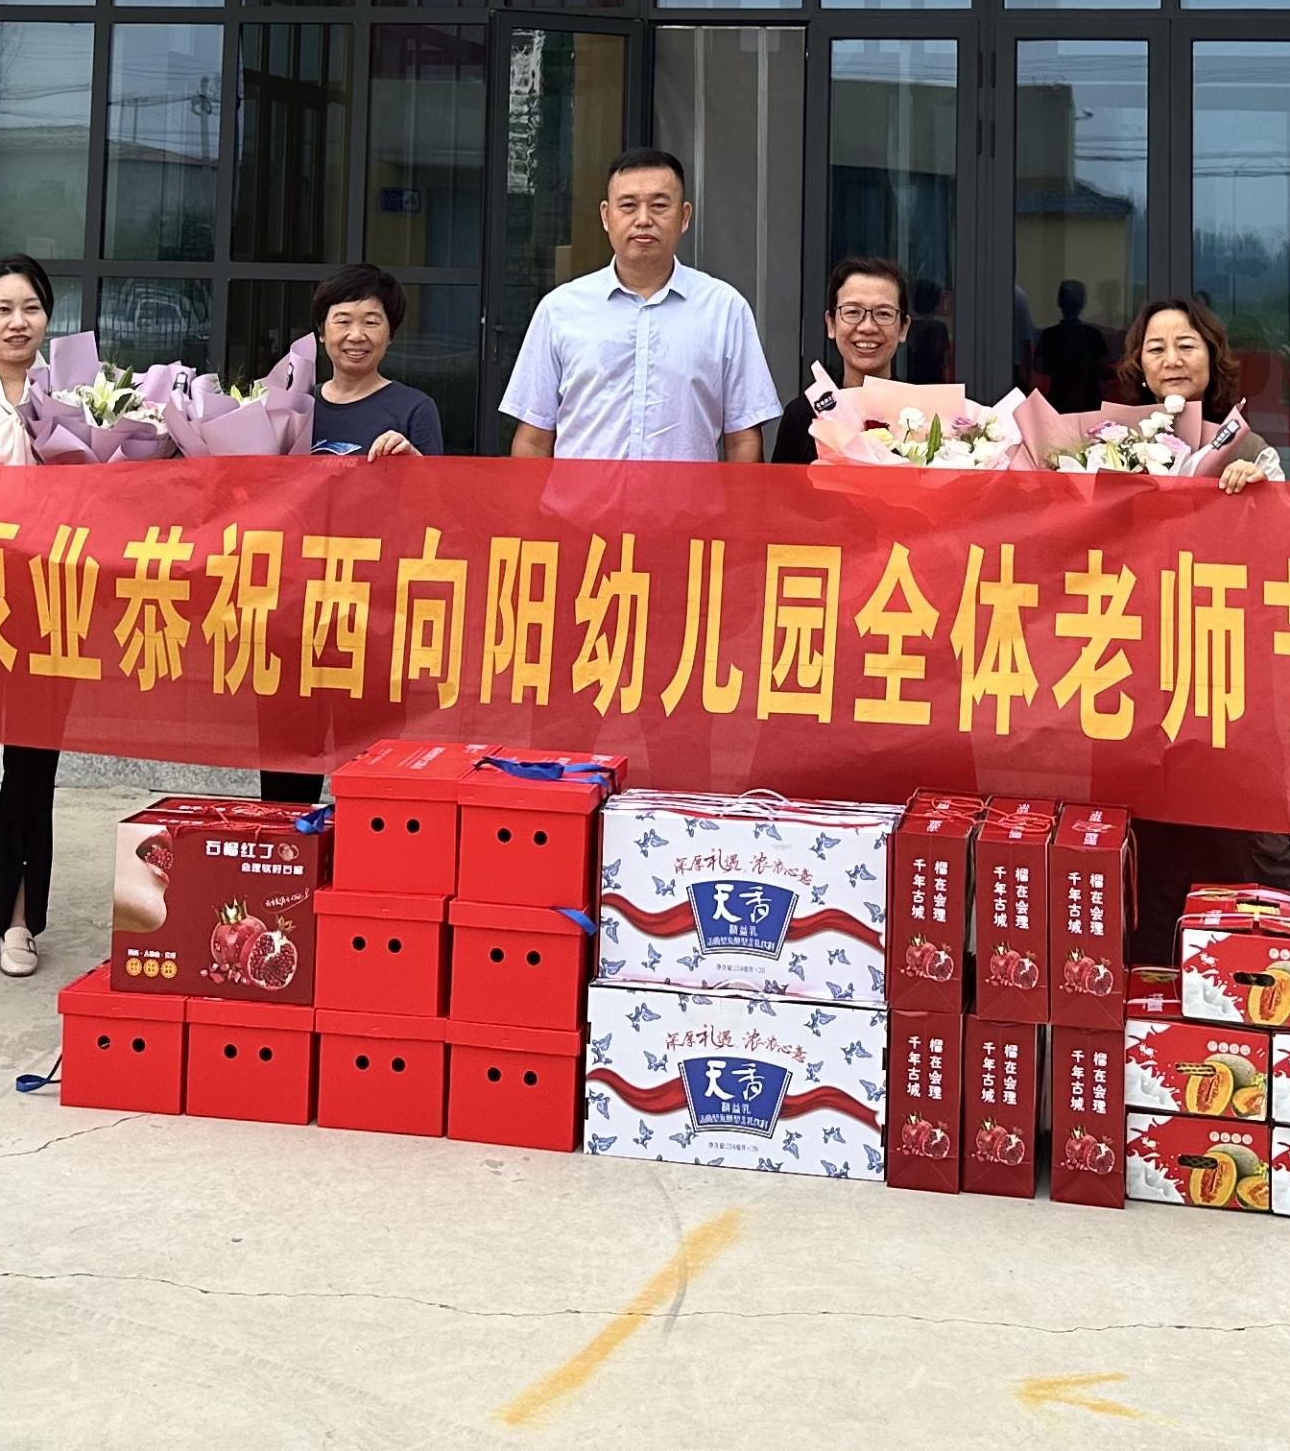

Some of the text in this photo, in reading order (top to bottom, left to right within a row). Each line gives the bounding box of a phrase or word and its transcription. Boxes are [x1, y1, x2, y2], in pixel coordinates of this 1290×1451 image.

[712, 883, 774, 925] 天香
[911, 858, 927, 920] 千年古城
[932, 860, 948, 923] 榴在会理
[993, 866, 1008, 928] 千年古城
[1014, 867, 1030, 930] 榴在会理
[1067, 871, 1083, 935] 千年古城
[1089, 873, 1105, 937] 榴在会理
[704, 1060, 767, 1102] 天香
[906, 1035, 922, 1099] 千年古城
[928, 1037, 944, 1101] 榴在会理
[981, 1041, 997, 1104] 千年古城
[1003, 1043, 1020, 1106] 榴在会理
[1070, 1049, 1086, 1113] 千年古城
[1092, 1051, 1108, 1115] 榴在会理
